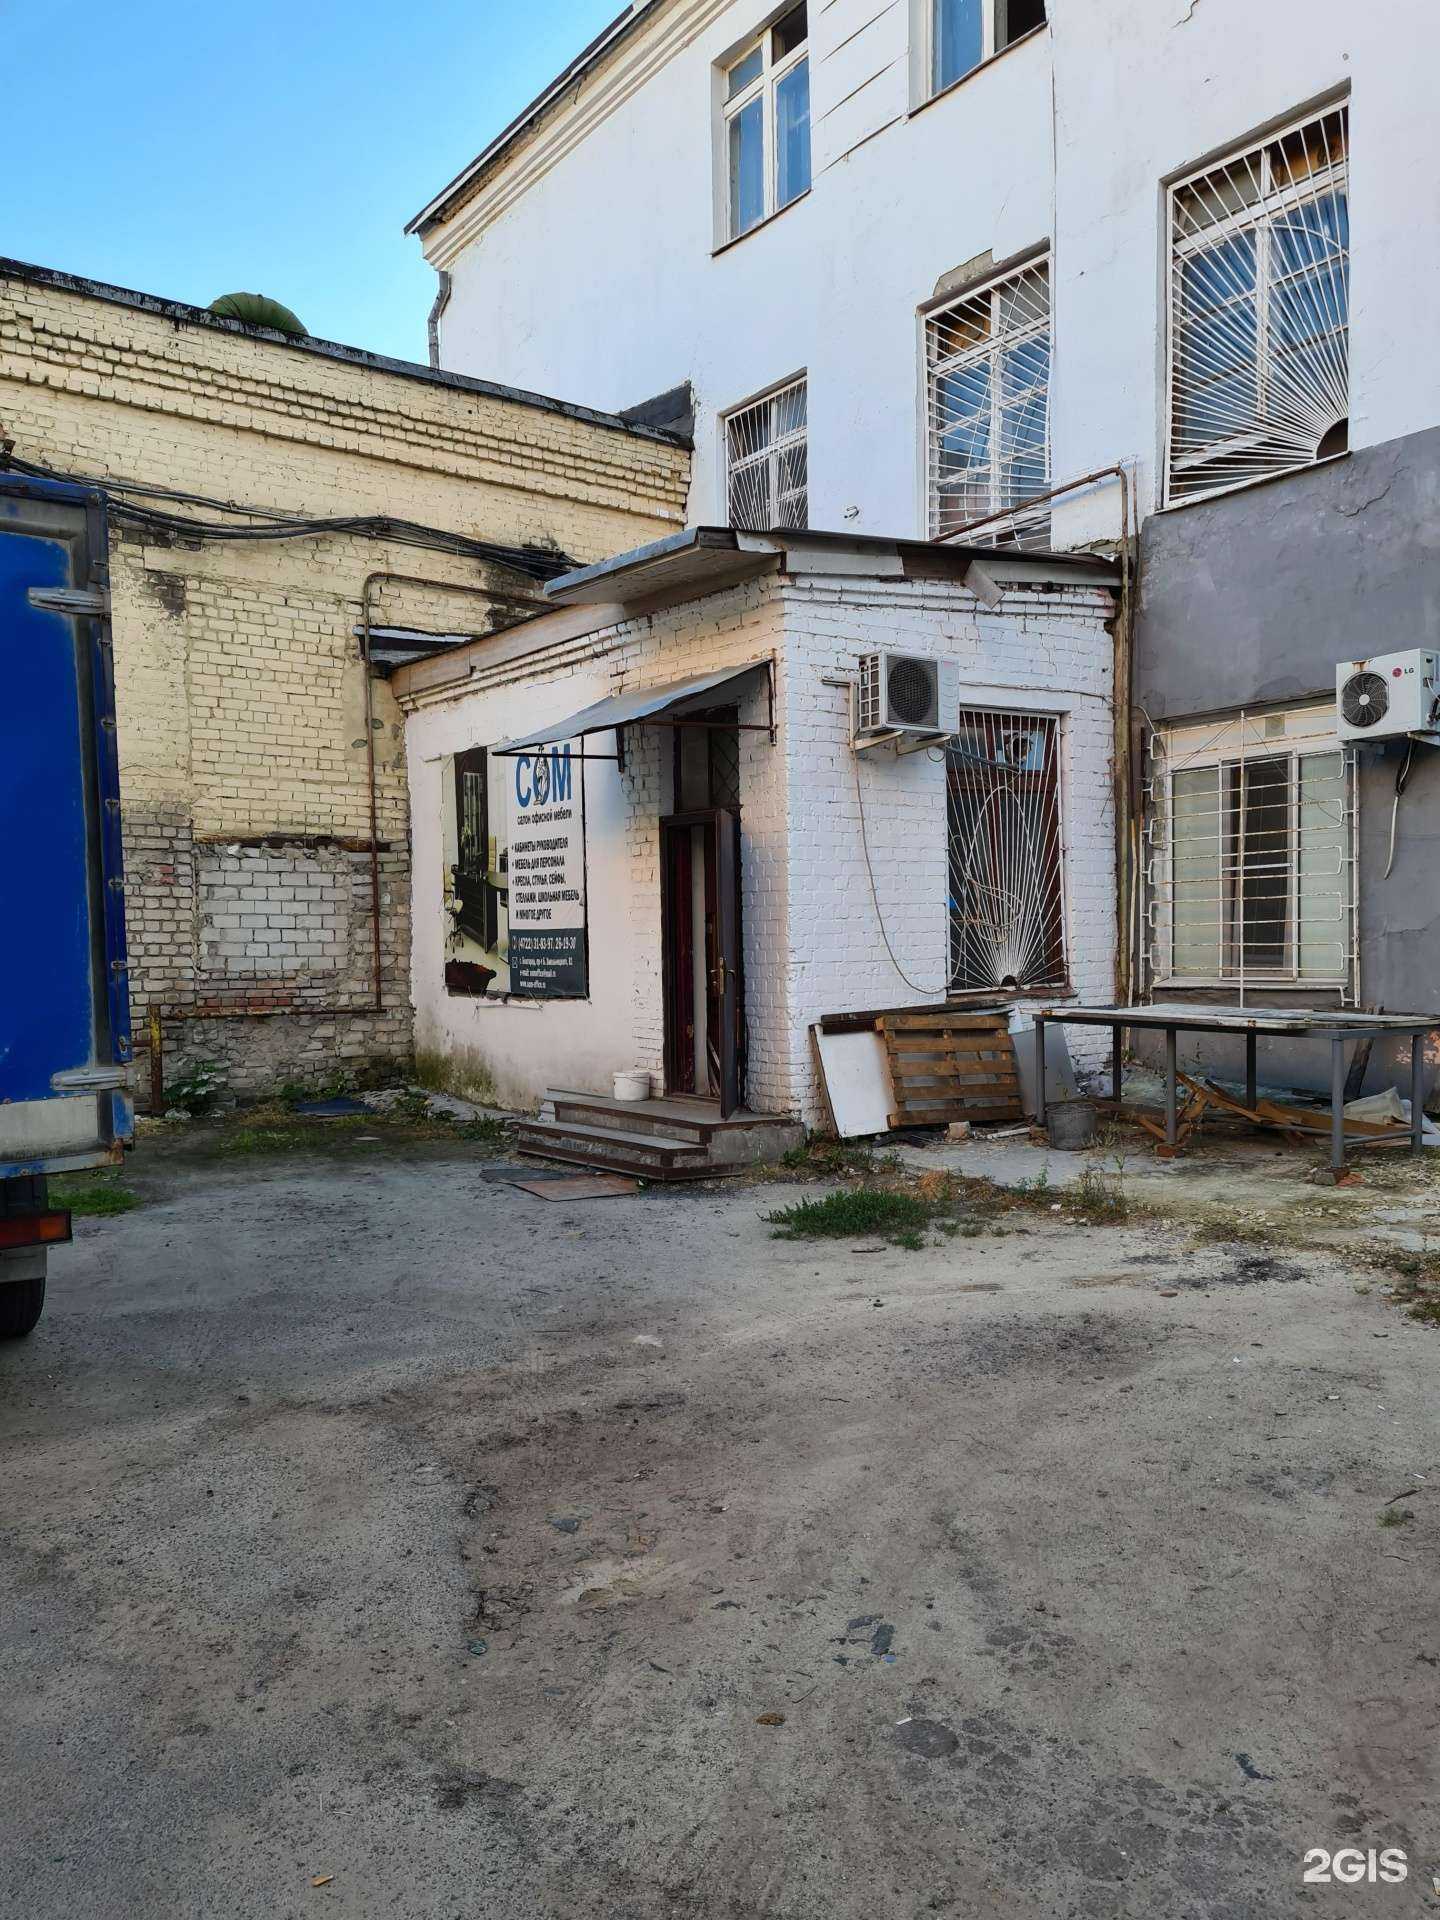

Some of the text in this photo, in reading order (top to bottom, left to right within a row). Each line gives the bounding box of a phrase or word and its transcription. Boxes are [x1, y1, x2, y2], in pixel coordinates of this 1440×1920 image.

[517, 807, 572, 826] салон офисной мебели
[515, 858, 531, 870] МЕБЕЛЬ
[540, 855, 565, 868] ПЕРСОНАЛА
[561, 889, 579, 901] МЕБЕЛЬ
